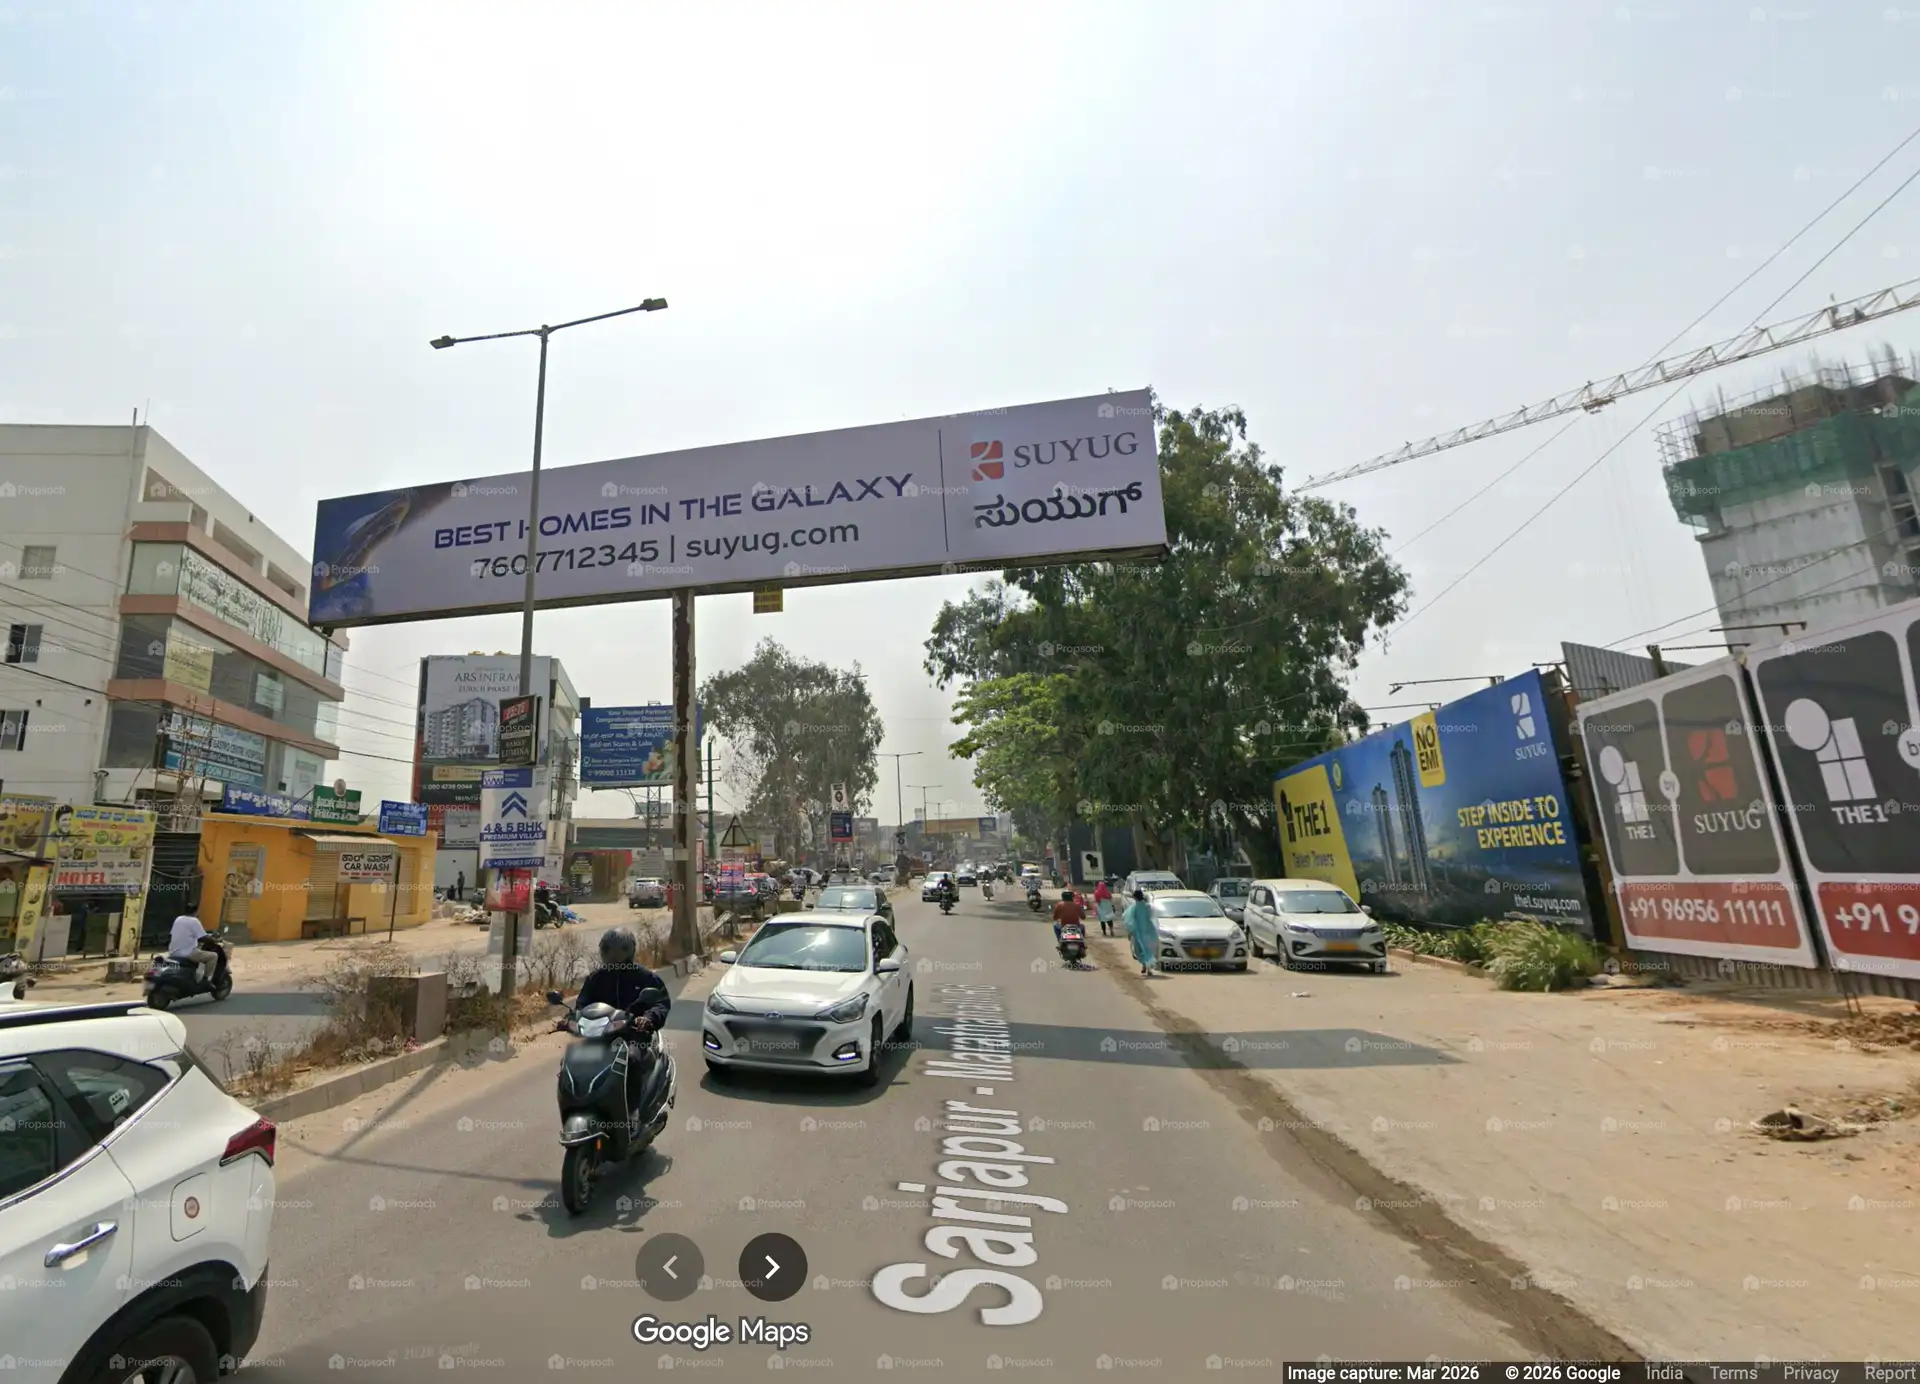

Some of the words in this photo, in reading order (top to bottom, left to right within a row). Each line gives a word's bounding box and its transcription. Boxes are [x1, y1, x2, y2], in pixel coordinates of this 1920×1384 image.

[1013, 431, 1138, 468] SUYUG
[434, 521, 511, 549] BEST
[519, 507, 632, 540] HOMES
[641, 501, 671, 526] IN
[679, 493, 743, 522] THE
[752, 473, 913, 512] GALAXY
[974, 481, 1143, 529] ಸುಯುಗ್
[474, 540, 659, 579] 7607712345
[685, 521, 859, 563] suyug.com
[455, 672, 477, 682] ARS
[1416, 724, 1435, 751] NO
[1419, 748, 1440, 772] EMI
[1514, 742, 1548, 761] SUYUG
[1458, 805, 1485, 828] STEP
[1487, 798, 1535, 825] INSIDE
[1535, 794, 1560, 819] TO
[1694, 808, 1762, 834] SUYUG
[484, 823, 491, 832] 4
[495, 822, 502, 832] &
[517, 821, 543, 831] BHK
[1477, 821, 1567, 849] EXPERIENCE
[56, 872, 106, 885] HOTEL
[344, 863, 361, 871] CAR
[364, 863, 390, 871] WASH
[1629, 896, 1659, 920] +91
[1661, 898, 1721, 923] 96956
[1723, 900, 1787, 927] 11111
[1835, 902, 1892, 934] +91
